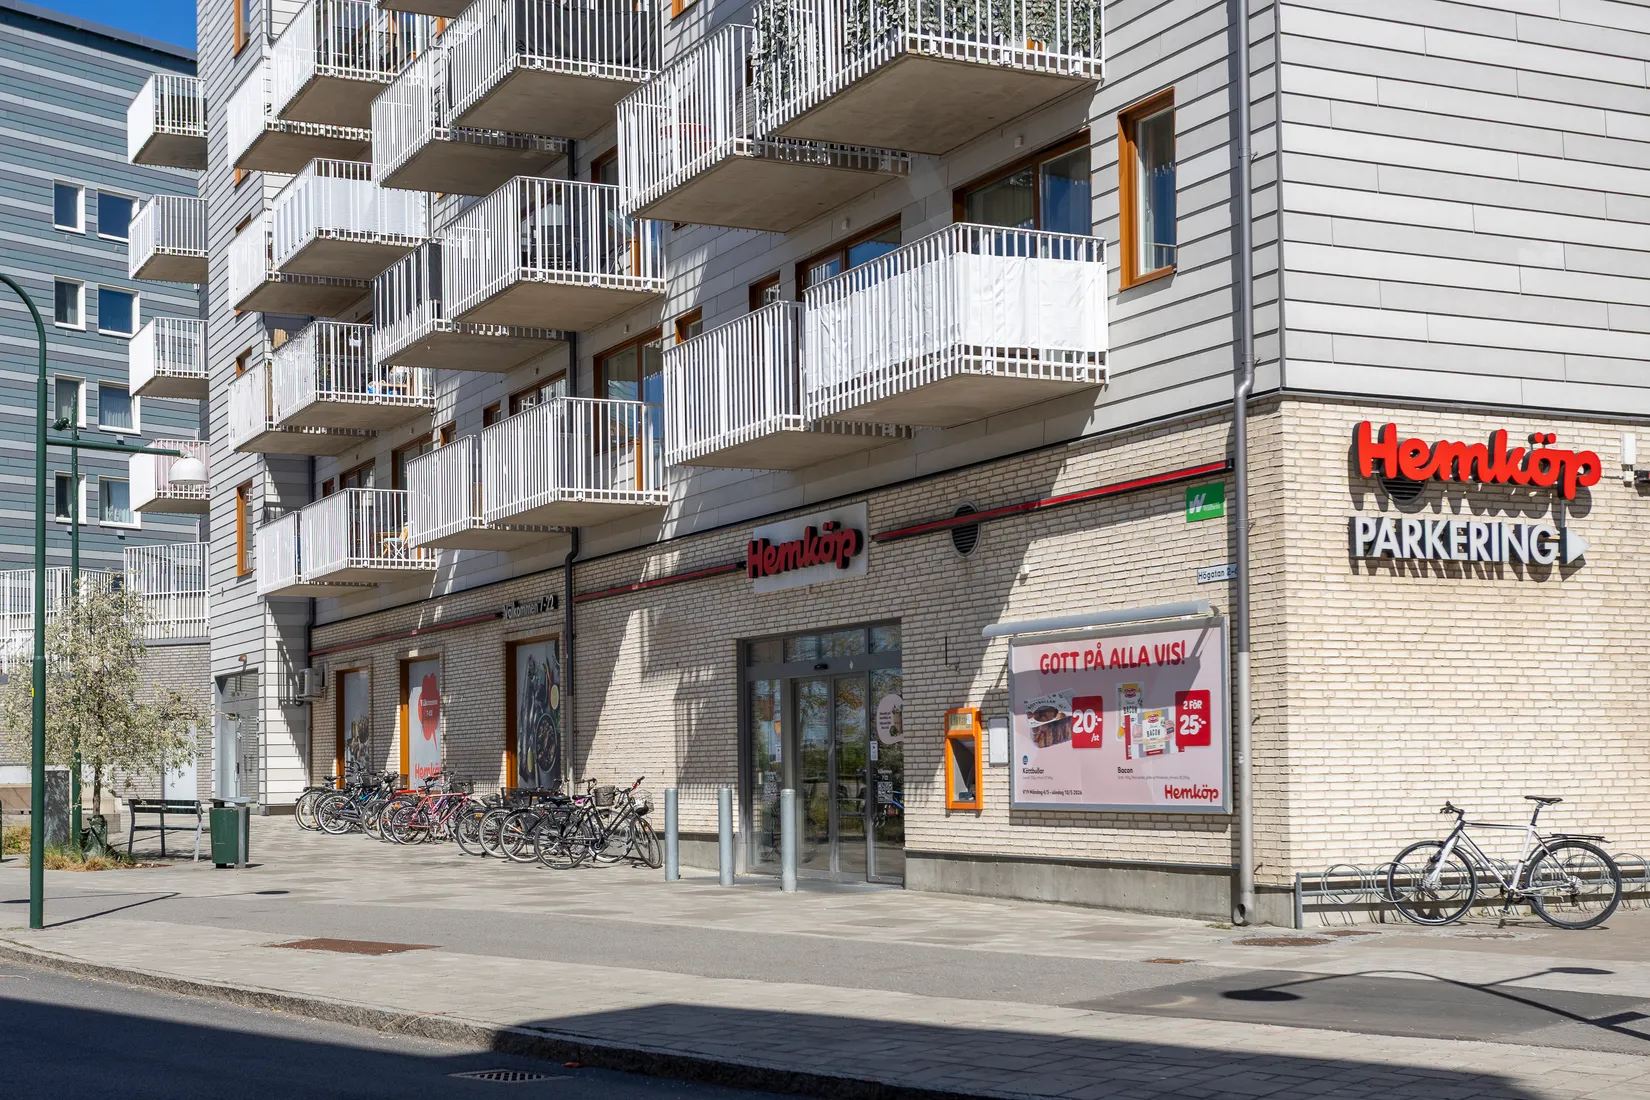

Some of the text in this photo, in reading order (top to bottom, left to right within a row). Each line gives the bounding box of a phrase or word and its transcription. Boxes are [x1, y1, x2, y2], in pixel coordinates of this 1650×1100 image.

[1355, 420, 1602, 500] Hemköp
[748, 521, 859, 578] Hemköp
[1354, 516, 1559, 565] PARKERING
[1198, 570, 1225, 580] Högatan
[1040, 640, 1186, 675] GOTT PÅ ALLA VIS!
[1183, 699, 1203, 710] 2 FÖR
[1072, 708, 1103, 734] 20:-
[1179, 714, 1207, 735] 25:-
[1090, 733, 1100, 742] /st
[1146, 729, 1161, 737] BACON
[1164, 784, 1219, 802] Hemköp
